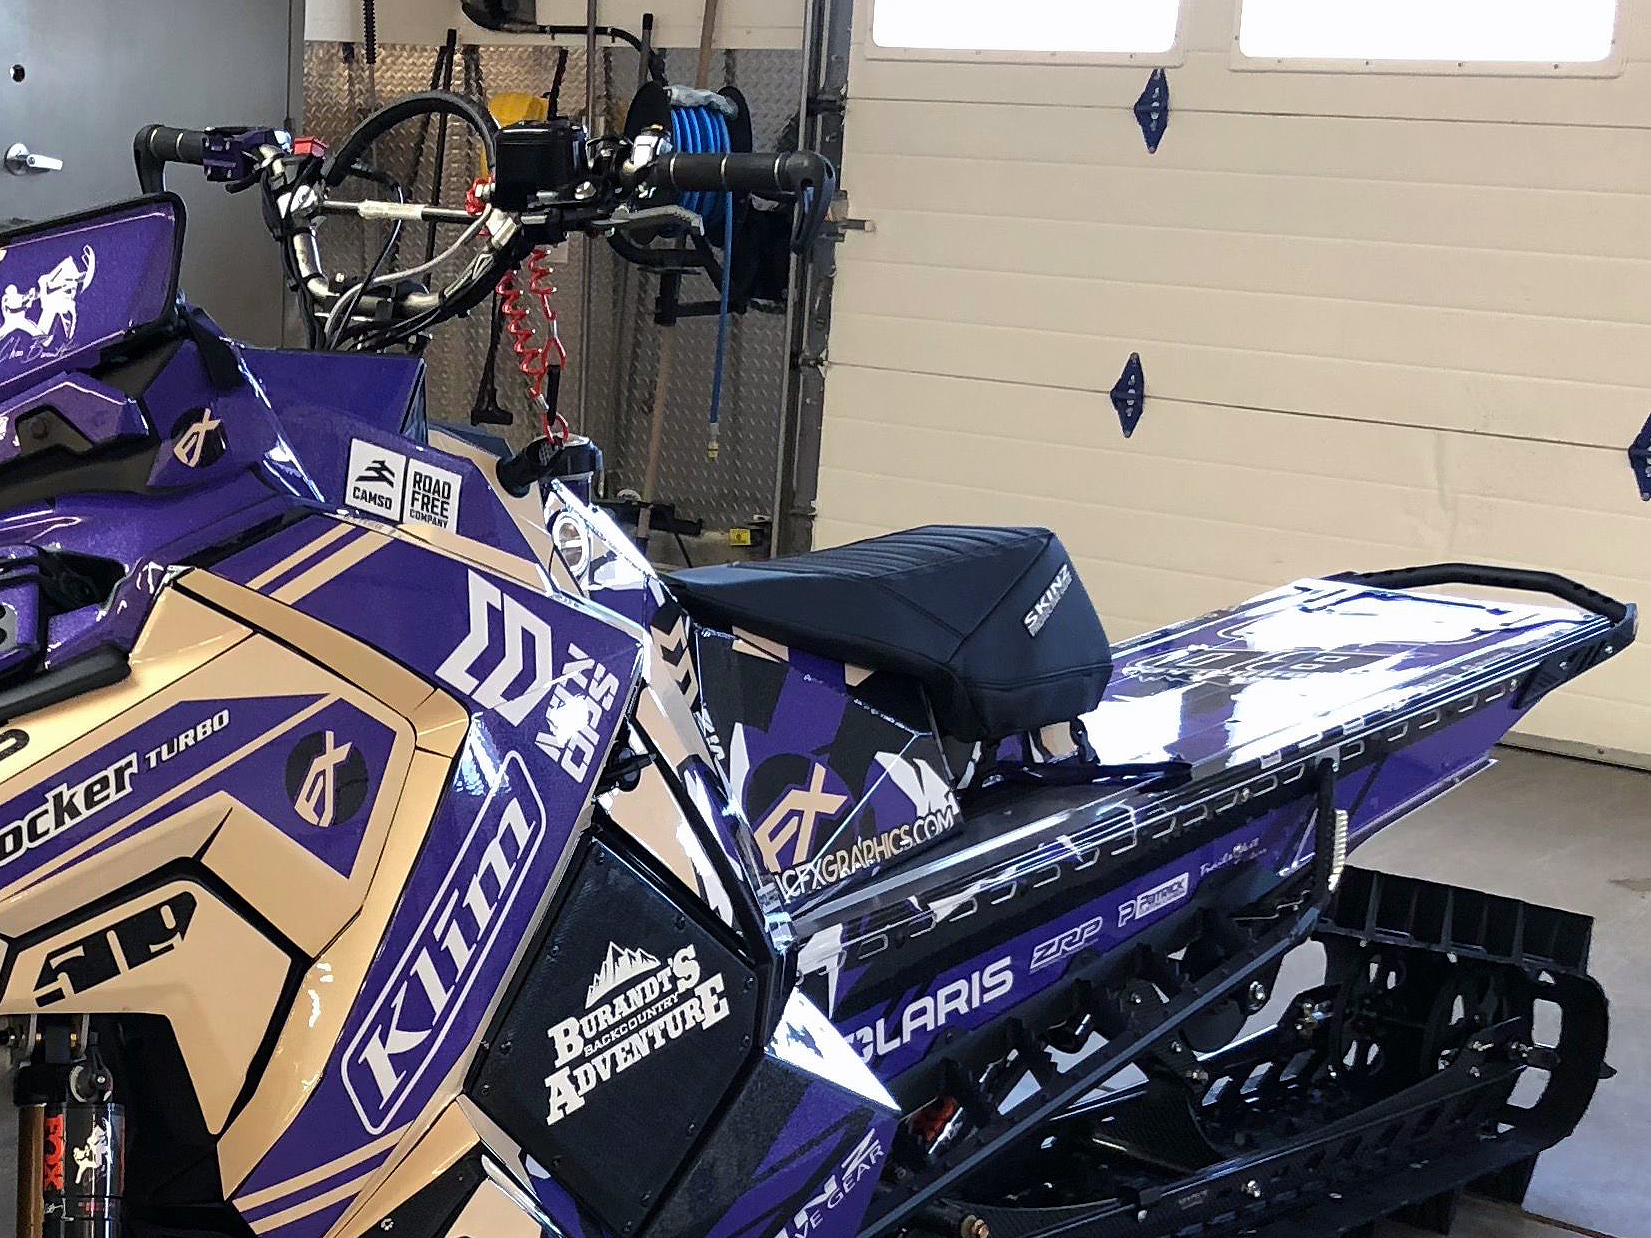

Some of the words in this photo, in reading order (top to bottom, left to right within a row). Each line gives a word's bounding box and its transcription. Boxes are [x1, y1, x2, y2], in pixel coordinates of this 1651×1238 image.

[352, 486, 392, 511] CAMSO
[409, 508, 448, 530] COMPANY
[410, 489, 450, 521] FREE
[412, 471, 451, 501] ROAD
[1024, 563, 1070, 629] SKINZ
[145, 708, 231, 773] TURBO
[560, 662, 620, 784] OPS
[357, 797, 537, 1110] Klim
[544, 973, 731, 1127] ADVENTURE
[584, 991, 683, 1057] BACKCOUNTRY
[44, 1113, 64, 1191] FOX
[820, 1139, 886, 1210] GEAR
